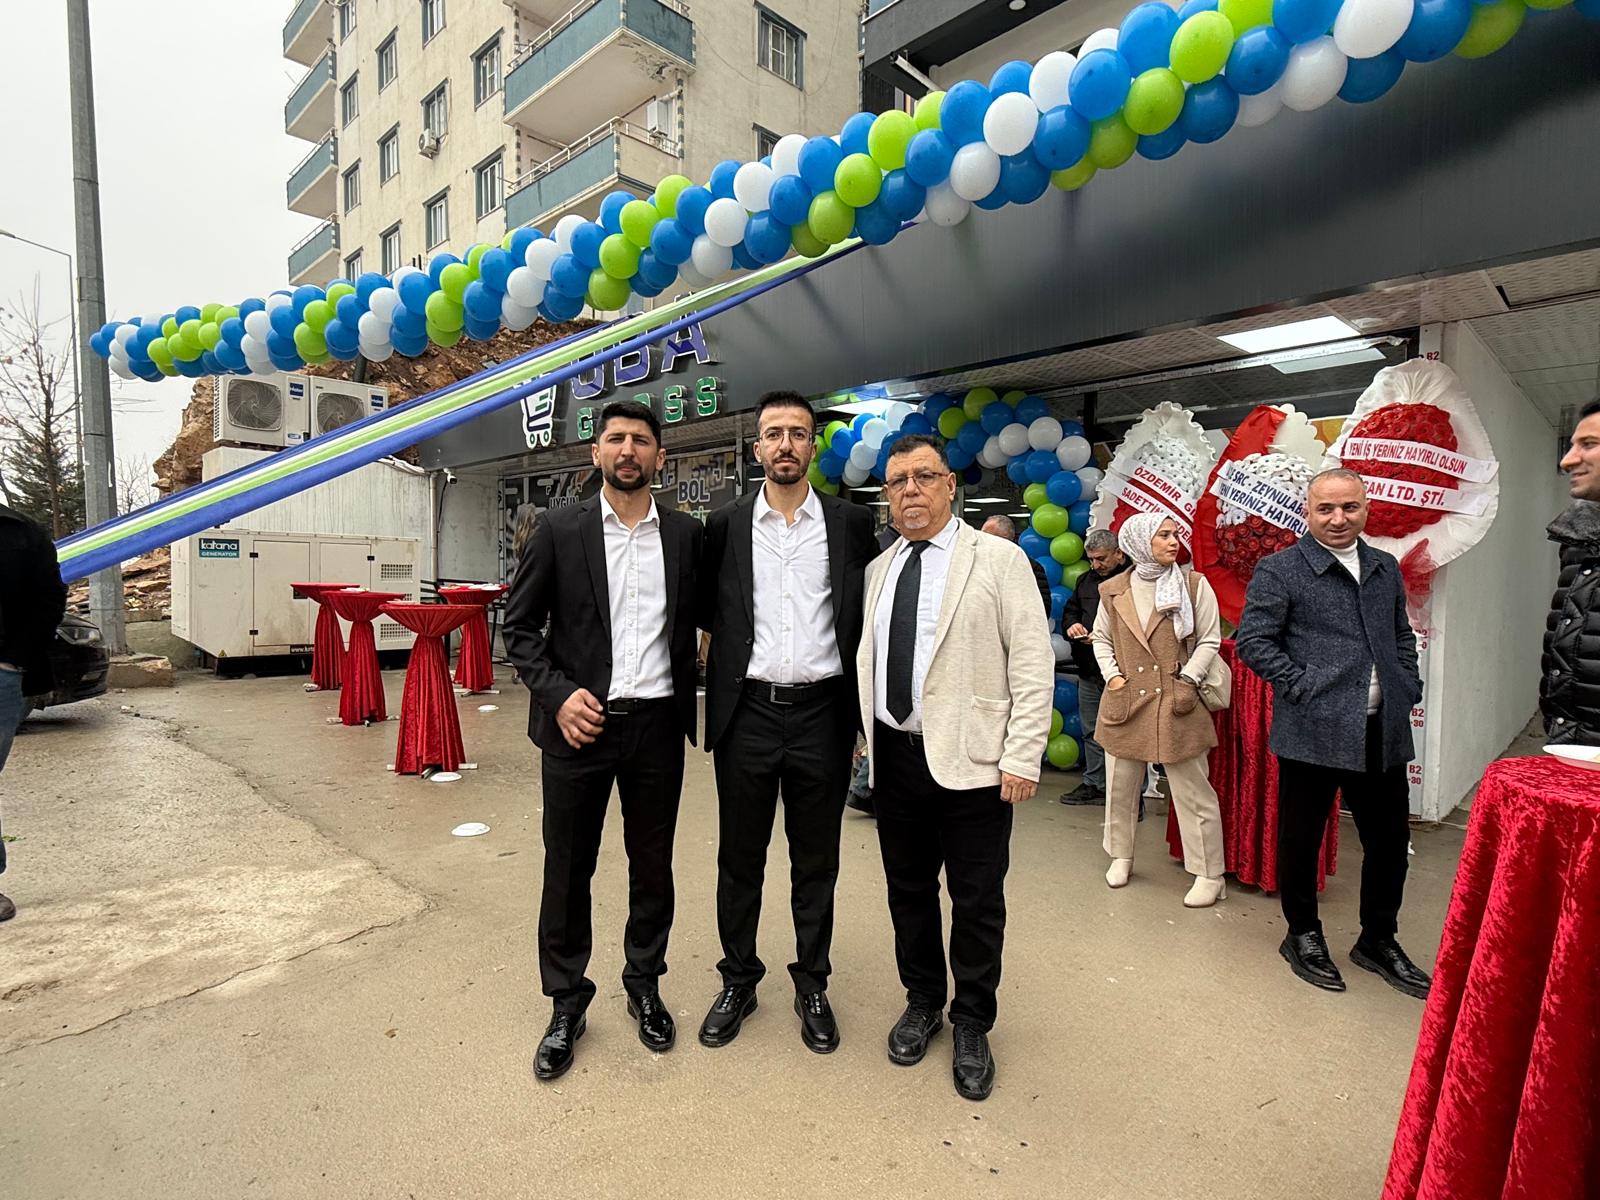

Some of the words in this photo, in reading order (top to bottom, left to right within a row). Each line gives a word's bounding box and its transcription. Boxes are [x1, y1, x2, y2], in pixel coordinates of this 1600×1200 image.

[577, 376, 717, 440] GSS
[1373, 442, 1405, 459] YERİNİZ
[1404, 446, 1440, 466] HAYIRLI
[1439, 454, 1468, 475] OLSUN
[678, 478, 711, 504] BOL
[1134, 465, 1182, 502] ÖZDEMİR
[1386, 484, 1417, 502] LTD.
[1420, 489, 1446, 507] ŞTİ.
[1228, 487, 1268, 514] YERİNİZ
[1265, 505, 1308, 536] HAYIRLI
[201, 539, 238, 551] katana
[1411, 708, 1425, 718] B2
[1408, 764, 1423, 775] B2
